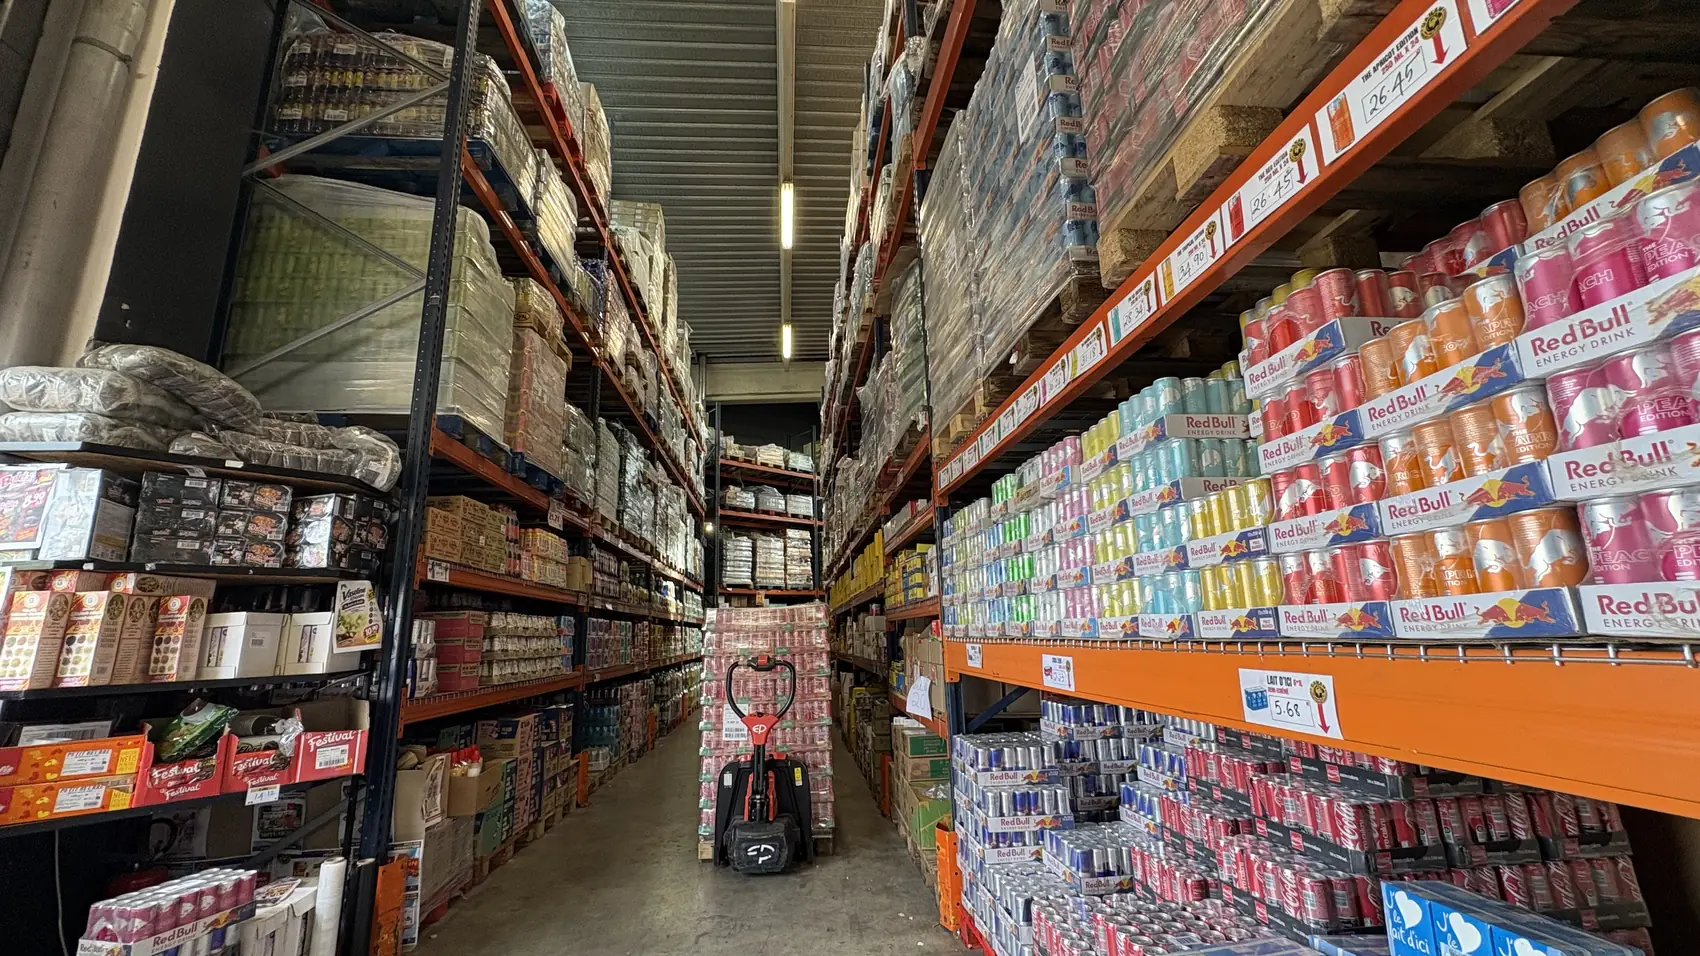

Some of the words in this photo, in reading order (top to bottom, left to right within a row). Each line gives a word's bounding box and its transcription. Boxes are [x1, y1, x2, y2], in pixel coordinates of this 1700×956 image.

[1361, 71, 1372, 84] THE
[1373, 47, 1396, 75] APRICOT
[1395, 26, 1419, 51] EDITION
[1075, 160, 1087, 169] Re
[1567, 205, 1601, 232] Bull
[1086, 247, 1098, 257] Re
[1647, 252, 1689, 273] EDITION
[1370, 321, 1392, 336] Re
[1530, 324, 1578, 357] Red
[1579, 303, 1631, 340] Bull
[1536, 343, 1586, 368] ENERGY
[1591, 326, 1636, 352] DRINK
[1249, 365, 1268, 385] Red
[1268, 355, 1286, 376] Bull
[1368, 400, 1398, 422] Red
[1397, 384, 1428, 411] Bull
[1186, 416, 1211, 428] Red
[1212, 415, 1236, 428] Bull
[1371, 414, 1403, 431] ENERGY
[1403, 402, 1431, 420] DRINK
[1262, 446, 1282, 462] Red
[1282, 434, 1304, 452] Bull
[1565, 452, 1613, 480] Red
[1619, 439, 1673, 468] Bull
[1204, 480, 1225, 492] Red
[1388, 498, 1419, 520] Red
[1418, 492, 1452, 513] Bull
[1274, 525, 1295, 540] Red
[1296, 519, 1317, 536] Bull
[1392, 518, 1424, 530] ENERGY
[1190, 546, 1204, 556] Red
[1204, 542, 1216, 554] Bull
[1276, 540, 1299, 548] ENERGY
[1597, 592, 1651, 615] Red
[1654, 588, 1700, 615] Bul
[1202, 615, 1214, 626] Red
[1213, 614, 1227, 625] Bull
[1284, 611, 1306, 624] Red
[1307, 608, 1328, 623] Bull
[1400, 604, 1432, 623] Red
[1432, 602, 1465, 623] Bull
[1404, 624, 1438, 633] ENERGY
[1266, 675, 1279, 686] LAIT
[1274, 700, 1300, 718] 5.68
[307, 731, 355, 752] Festival
[151, 761, 201, 785] Festival
[232, 753, 276, 775] Festival
[247, 773, 279, 788] Festival
[990, 772, 1004, 781] Red
[1004, 771, 1018, 780] Bull
[164, 782, 200, 801] Festival
[1000, 817, 1015, 826] Red
[1016, 817, 1030, 825] Bull
[997, 849, 1011, 858] Red
[1012, 848, 1026, 857] Bull
[1085, 881, 1098, 889] Red
[1393, 912, 1403, 924] le
[152, 929, 177, 948] Red
[176, 921, 199, 940] Bull
[1389, 918, 1407, 944] lait
[1407, 929, 1430, 955] d'ici
[1447, 932, 1458, 950] le
